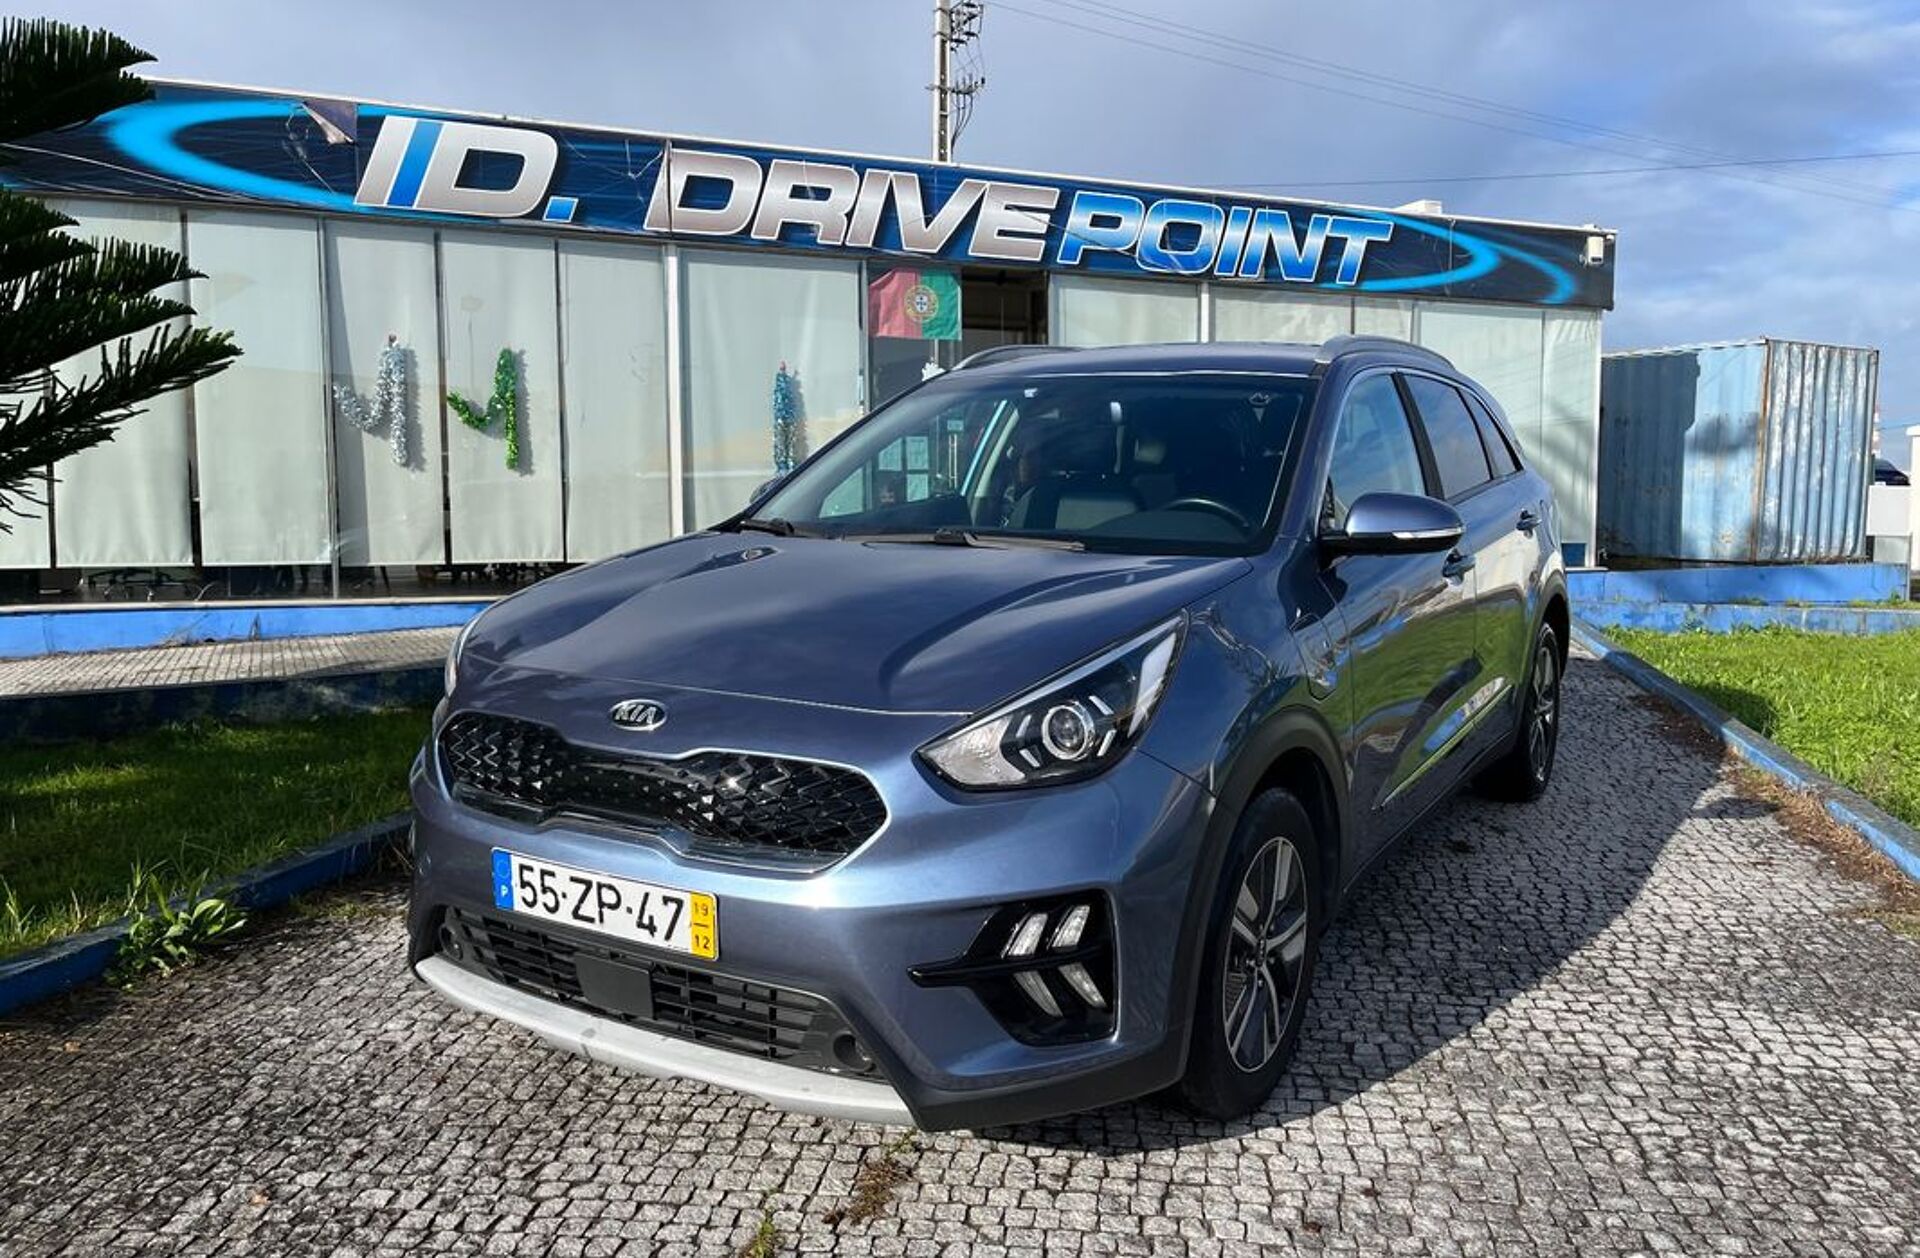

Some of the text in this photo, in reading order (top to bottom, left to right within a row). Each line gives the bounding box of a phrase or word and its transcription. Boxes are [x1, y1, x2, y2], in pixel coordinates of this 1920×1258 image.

[354, 115, 1396, 284] ID. DRIVE POINT
[613, 704, 657, 724] KIA
[694, 902, 709, 916] 19
[695, 934, 710, 950] 12
